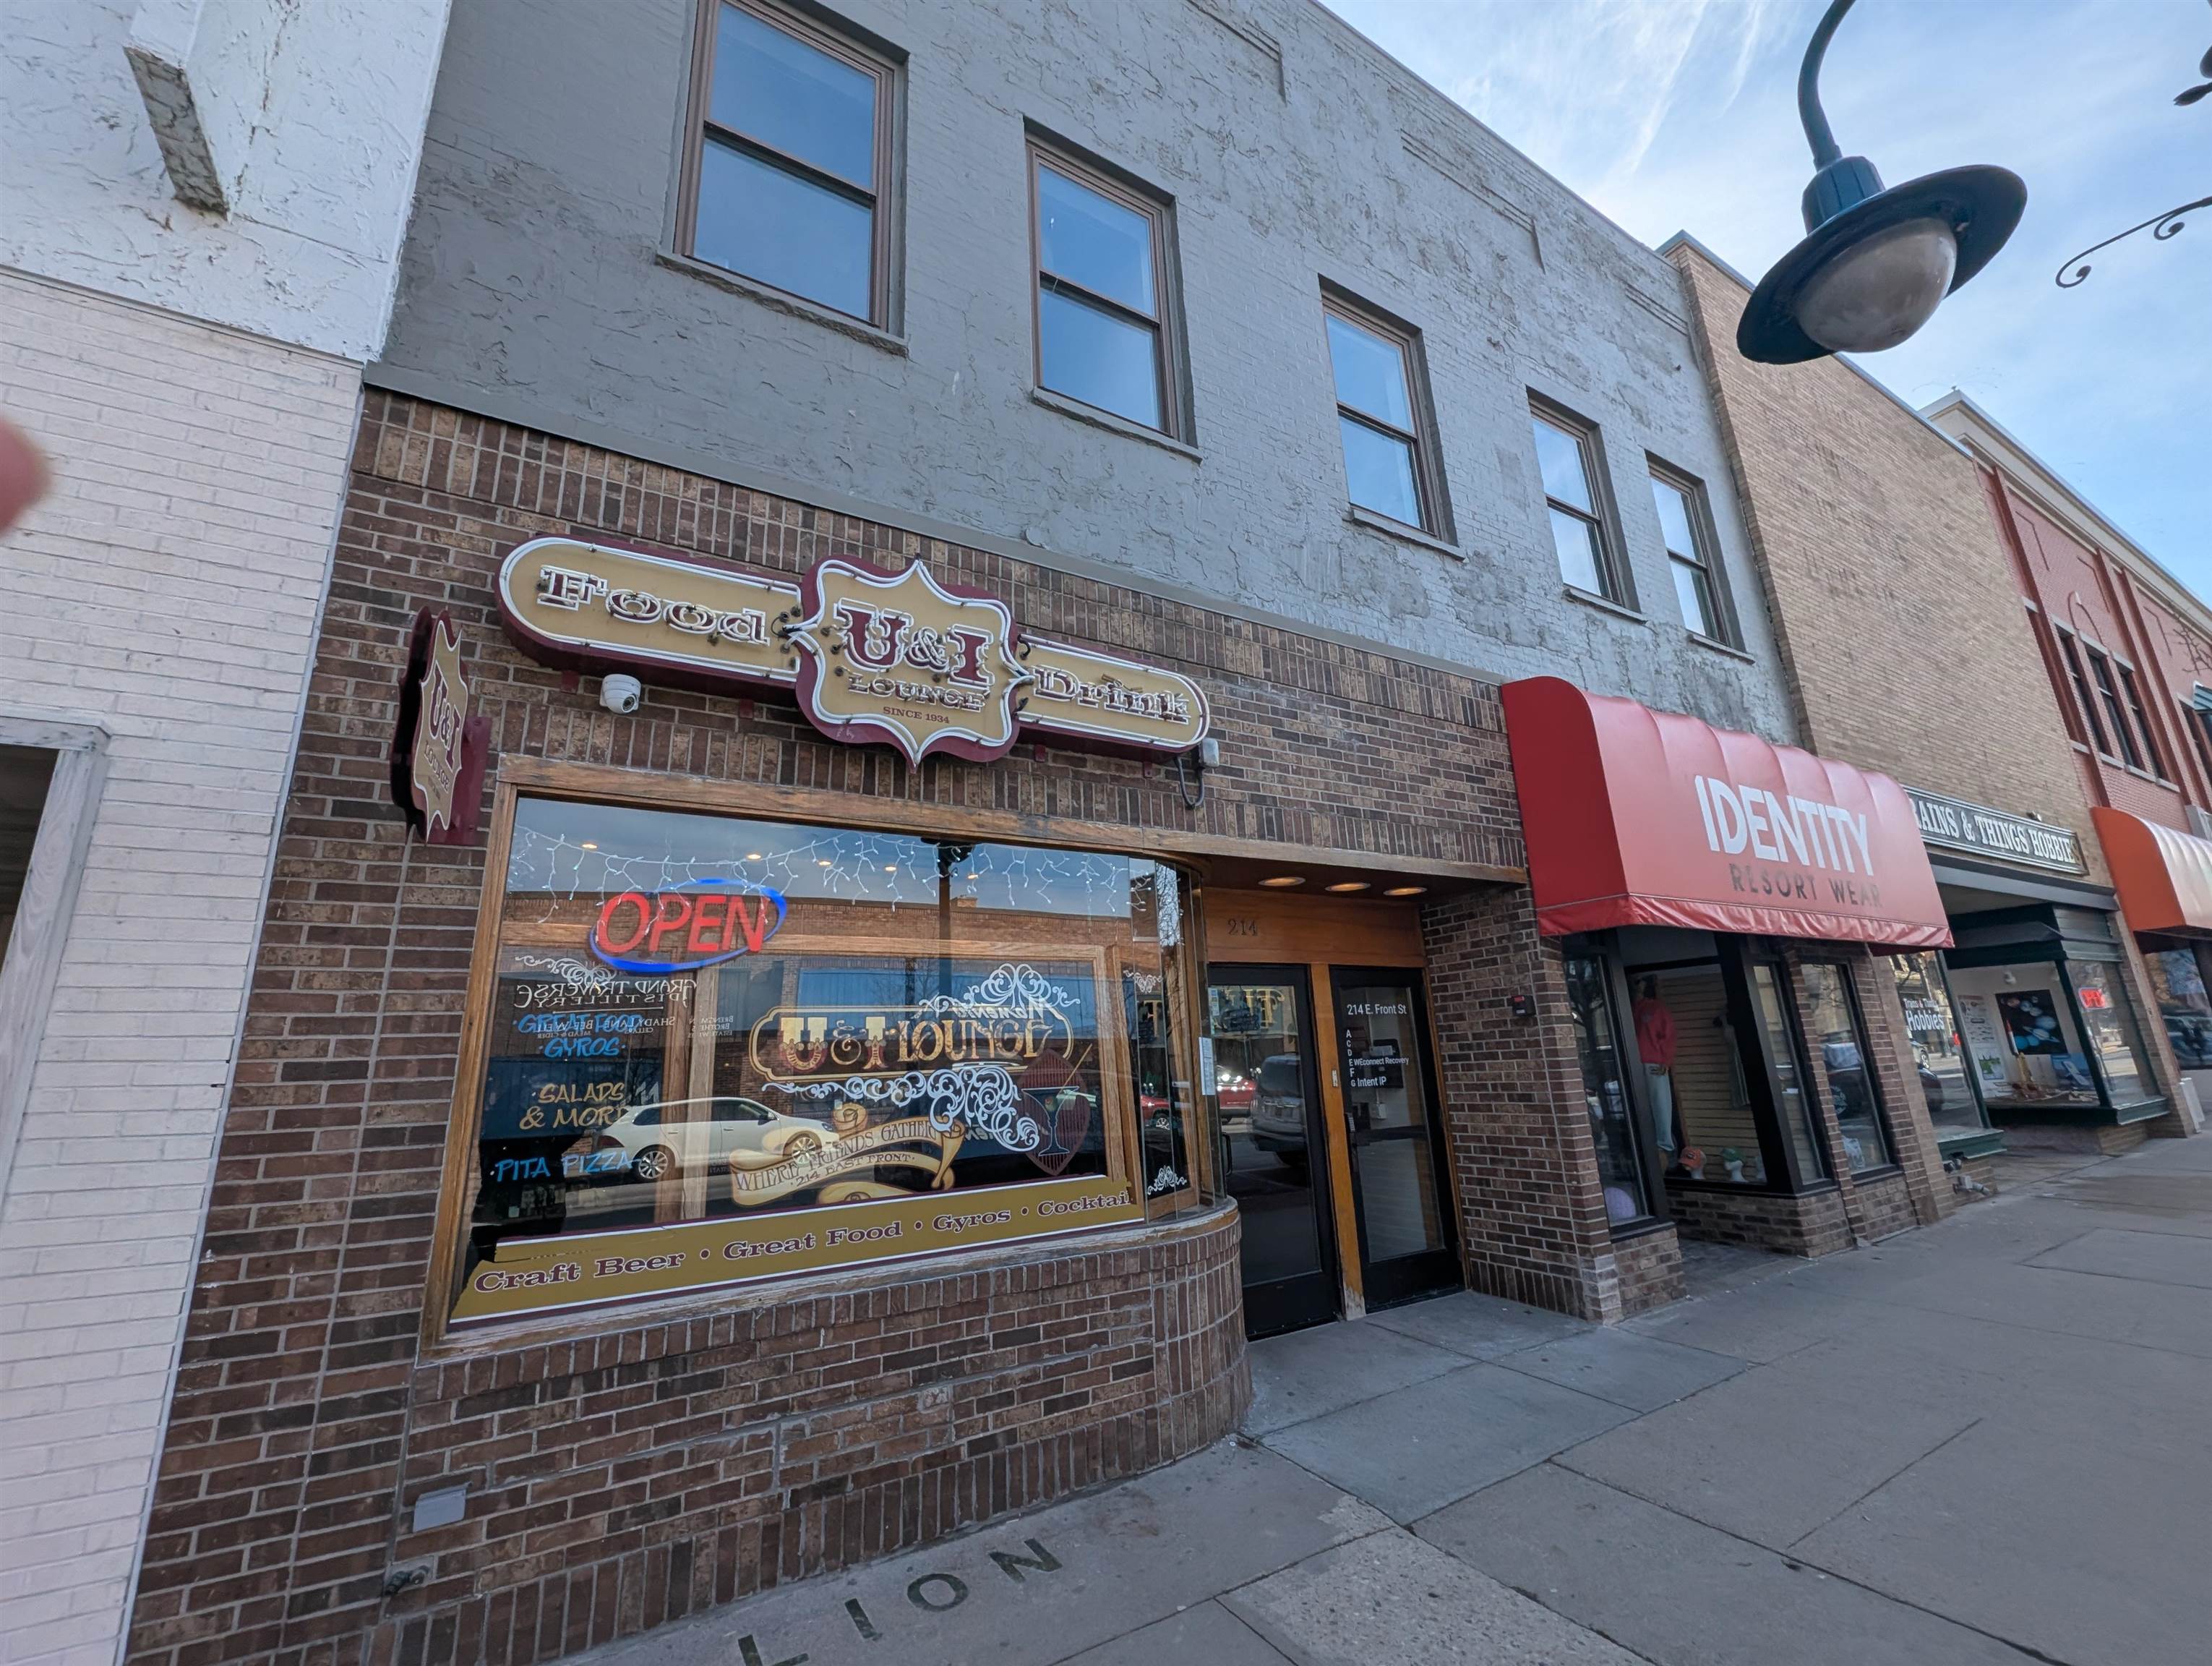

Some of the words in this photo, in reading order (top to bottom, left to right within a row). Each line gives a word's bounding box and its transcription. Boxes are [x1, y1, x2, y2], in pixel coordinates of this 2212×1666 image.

[537, 565, 771, 646] Food
[848, 672, 986, 712] LOUNGE
[1032, 665, 1191, 725] Drink
[883, 706, 922, 719] SINCE
[926, 714, 950, 724] 1934
[1695, 775, 1874, 876] IDENTITY
[1908, 798, 1960, 838] AINS
[1960, 811, 1976, 842] &
[1973, 815, 2029, 854] THINGS
[1730, 864, 1816, 901] RESORT
[1828, 876, 1885, 908] WEAR
[597, 893, 770, 952] OPEN
[1227, 918, 1259, 936] 214
[1347, 1004, 1363, 1015] 214
[1365, 1004, 1373, 1014] E.
[1375, 1004, 1397, 1014] Front
[1397, 1004, 1407, 1014] St
[1906, 1009, 1945, 1030] Hobbies
[595, 1013, 643, 1034] FOOD
[1346, 1029, 1352, 1038] A
[544, 1037, 620, 1058] GYROS
[897, 1019, 1053, 1062] LOUNGE
[1350, 1068, 1355, 1077] F
[1354, 1058, 1384, 1067] WEconnect
[538, 1082, 625, 1103] SALADS
[1358, 1077, 1379, 1087] Intent
[1379, 1076, 1386, 1085] IP
[519, 1106, 546, 1130] &
[495, 1157, 551, 1182] PITA
[561, 1151, 642, 1175] PIZZA
[734, 1161, 802, 1191] WHERE
[796, 1171, 820, 1186] 214
[826, 1157, 863, 1176] EAST
[474, 1262, 581, 1293] Craft
[593, 1252, 686, 1278] Beer
[723, 1232, 816, 1260] Great
[826, 1221, 902, 1247] Food
[933, 1209, 1011, 1234] Gyros
